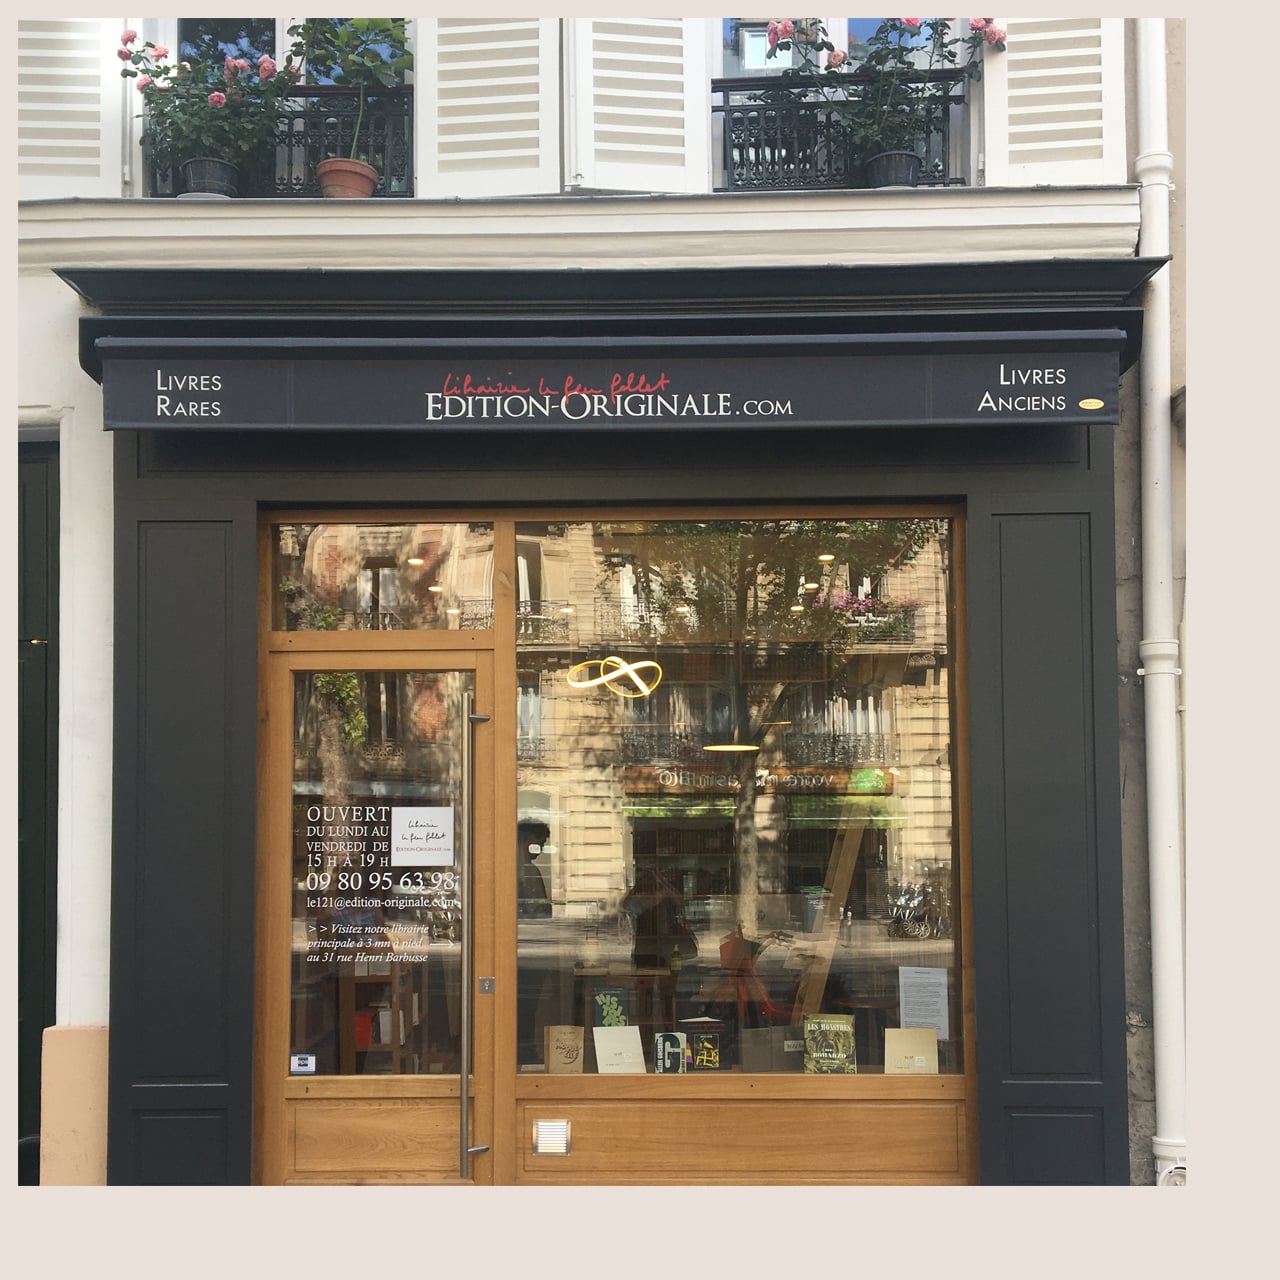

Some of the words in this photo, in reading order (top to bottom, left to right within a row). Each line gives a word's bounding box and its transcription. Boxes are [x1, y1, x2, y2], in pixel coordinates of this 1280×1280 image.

[157, 369, 222, 391] LIVRES
[1000, 364, 1066, 385] LIVRES
[157, 395, 221, 416] RARES
[977, 391, 1066, 412] ANCIENS
[307, 806, 390, 822] OUVERT
[307, 826, 325, 837] DU
[329, 826, 368, 837] LUNDI
[371, 826, 389, 837] AU
[306, 841, 367, 852] VENDREDI
[373, 841, 389, 852] DE
[307, 853, 322, 867] 15
[328, 856, 337, 867] H
[360, 853, 375, 867] 19
[380, 856, 389, 867] H
[306, 872, 331, 890] 09
[337, 872, 362, 890] 80
[369, 872, 393, 890] 95
[399, 872, 424, 890] 63
[431, 872, 455, 890] 98
[331, 924, 362, 934] Visitez
[364, 925, 389, 934] notre
[390, 923, 429, 934] librairie
[306, 938, 355, 950] principale
[365, 939, 372, 948] 3
[401, 938, 423, 950] pied
[306, 954, 320, 962] au
[322, 952, 333, 962] 31
[336, 954, 353, 962] rue
[354, 952, 383, 962] Henri
[385, 952, 428, 962] Barbusse
[807, 1023, 819, 1031] LES
